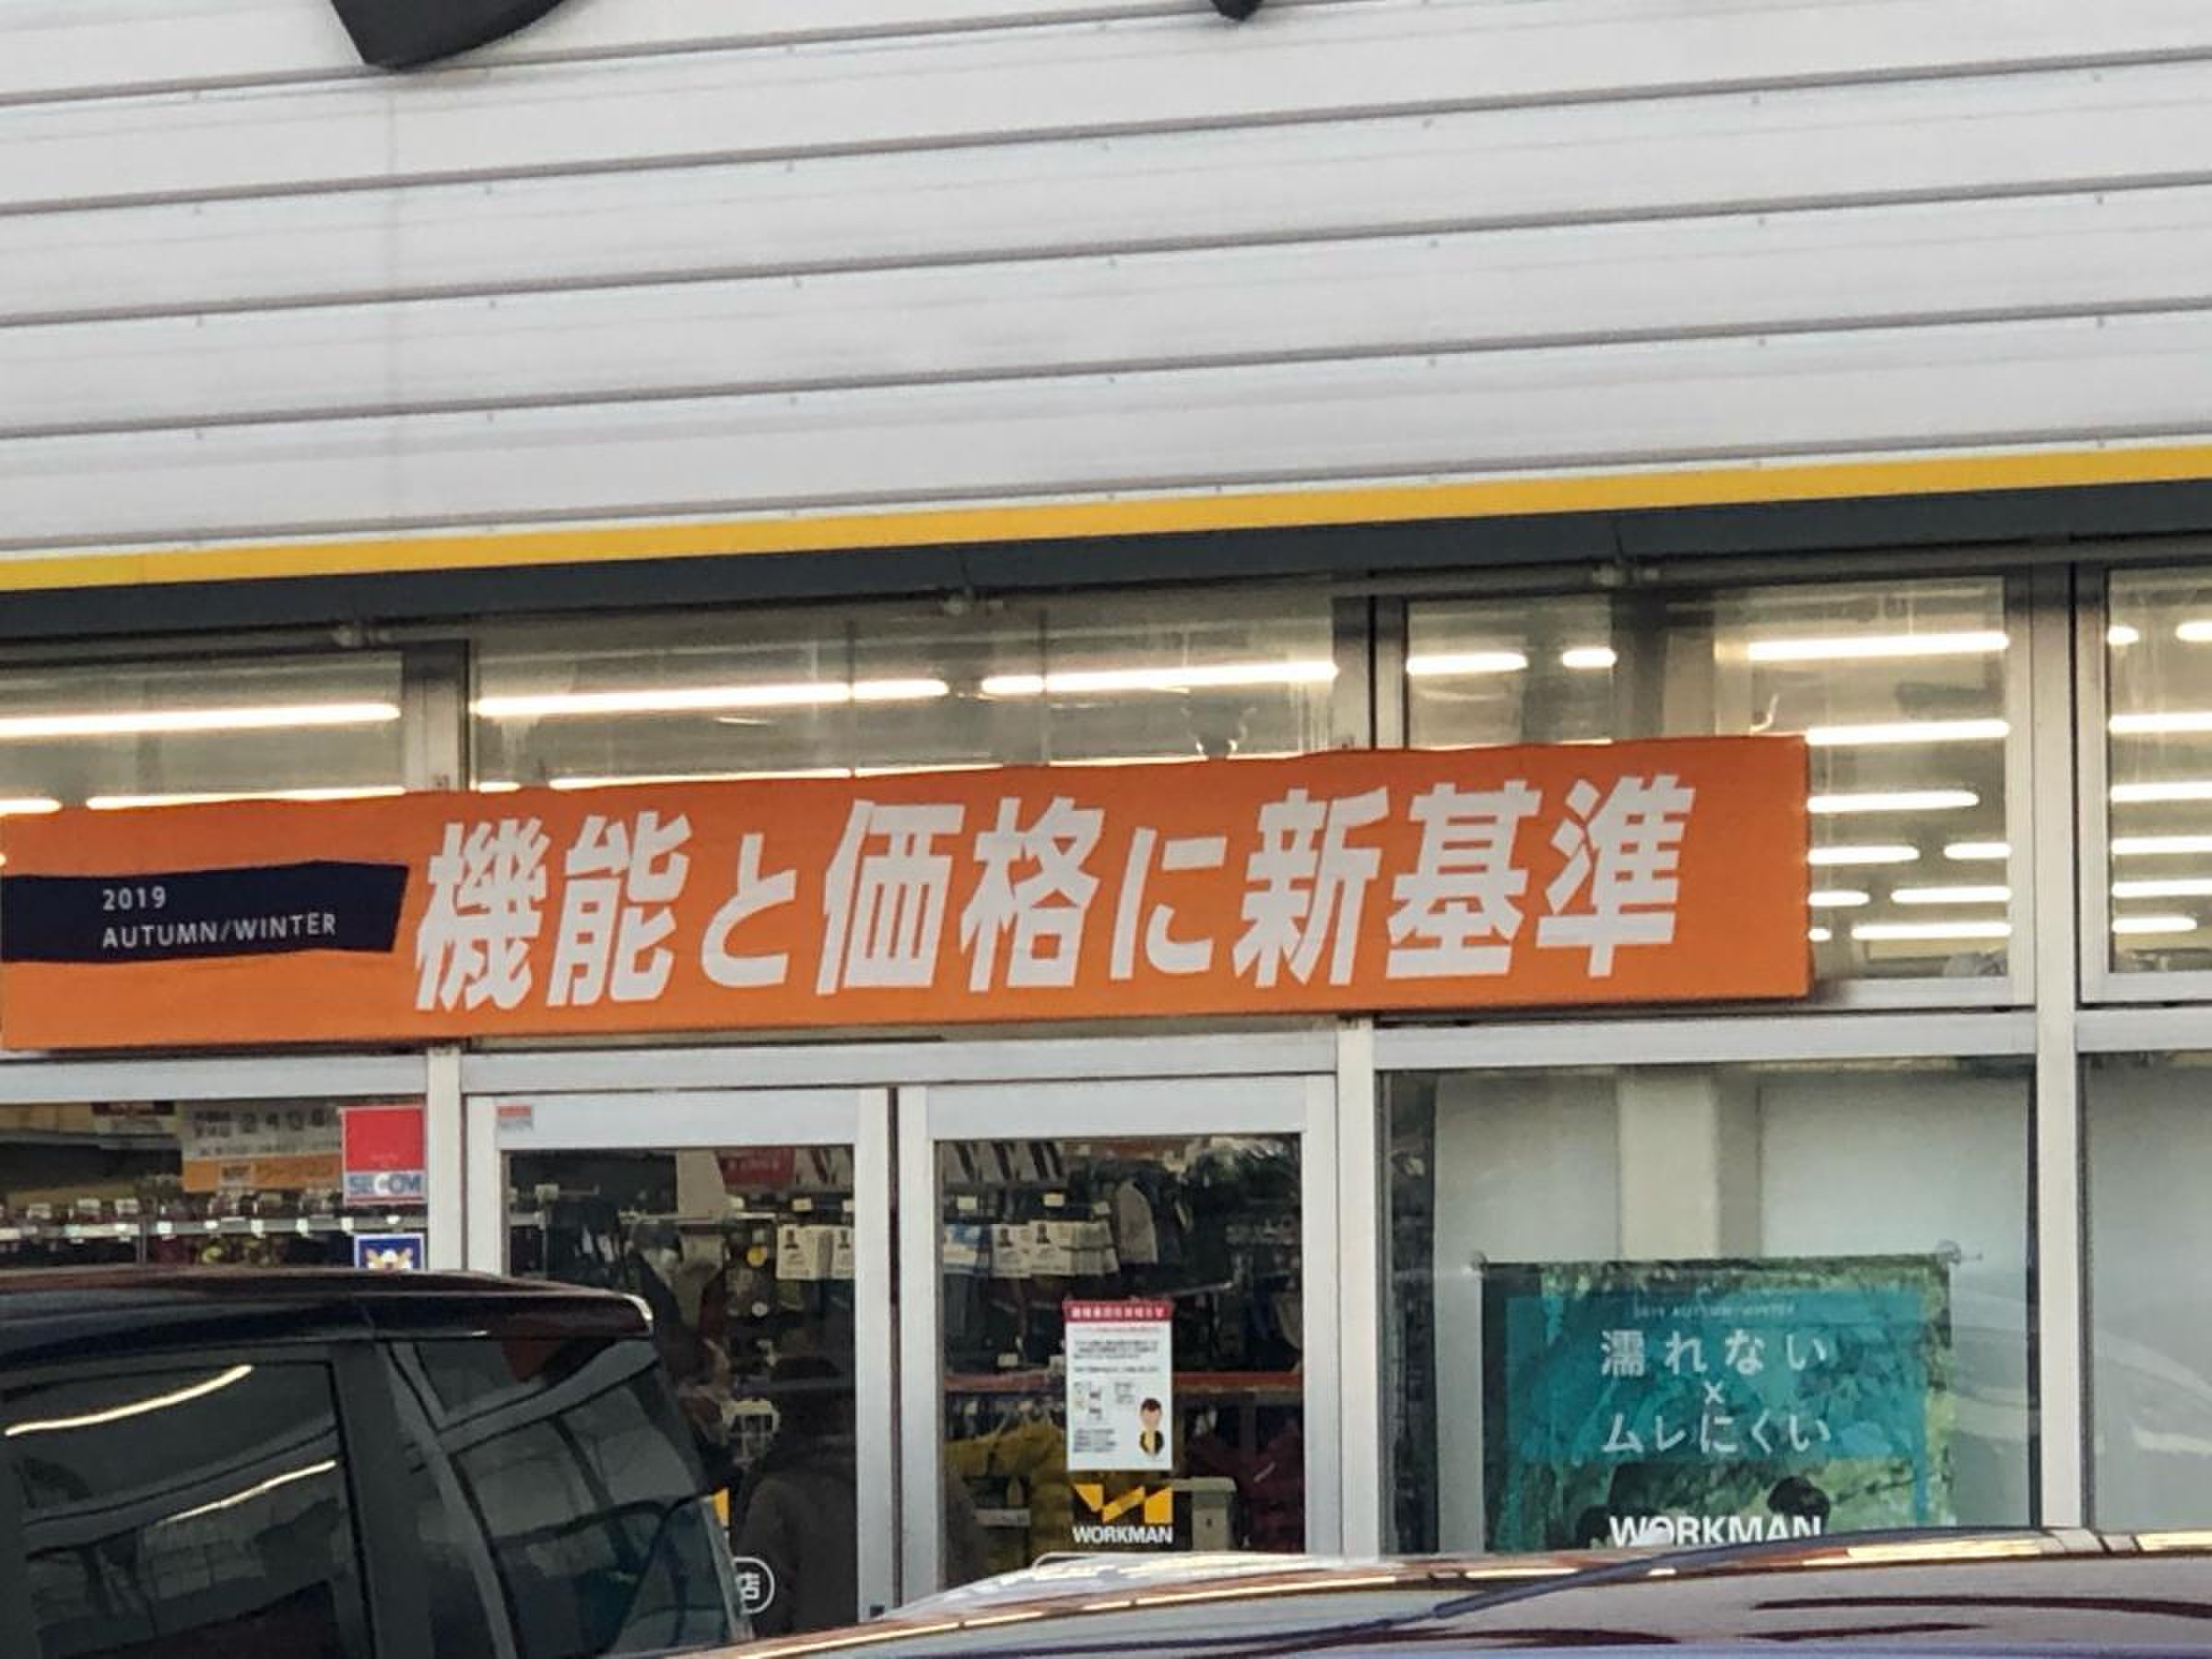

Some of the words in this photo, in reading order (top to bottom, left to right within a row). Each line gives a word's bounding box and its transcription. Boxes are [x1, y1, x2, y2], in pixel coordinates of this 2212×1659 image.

[102, 886, 167, 911] 2019
[414, 772, 1696, 1011] 機能と価格に新基準
[102, 912, 337, 949] AUTUMN/WINTER
[348, 1171, 422, 1196] SECOM
[1600, 1328, 1829, 1377] 濡れない
[1601, 1408, 1832, 1454] ムレにくい
[1072, 1524, 1174, 1544] WORKMAN
